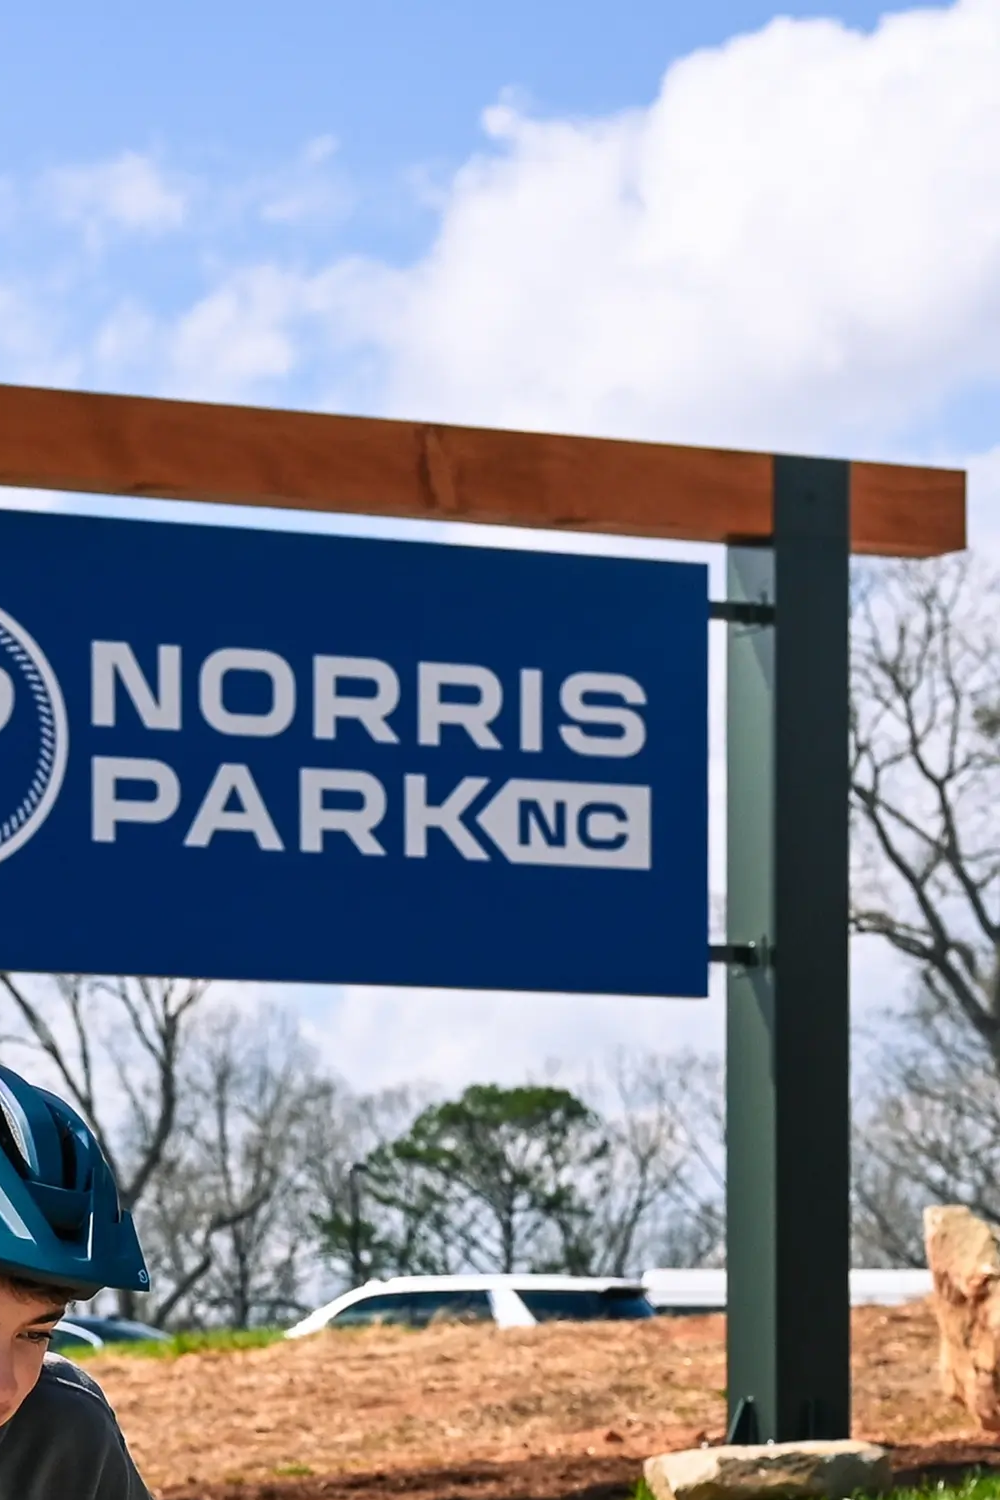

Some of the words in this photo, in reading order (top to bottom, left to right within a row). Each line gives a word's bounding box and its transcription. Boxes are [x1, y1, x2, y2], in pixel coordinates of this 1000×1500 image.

[91, 640, 646, 757] NORRIS
[92, 756, 489, 861] PARK
[517, 798, 629, 852] NC
